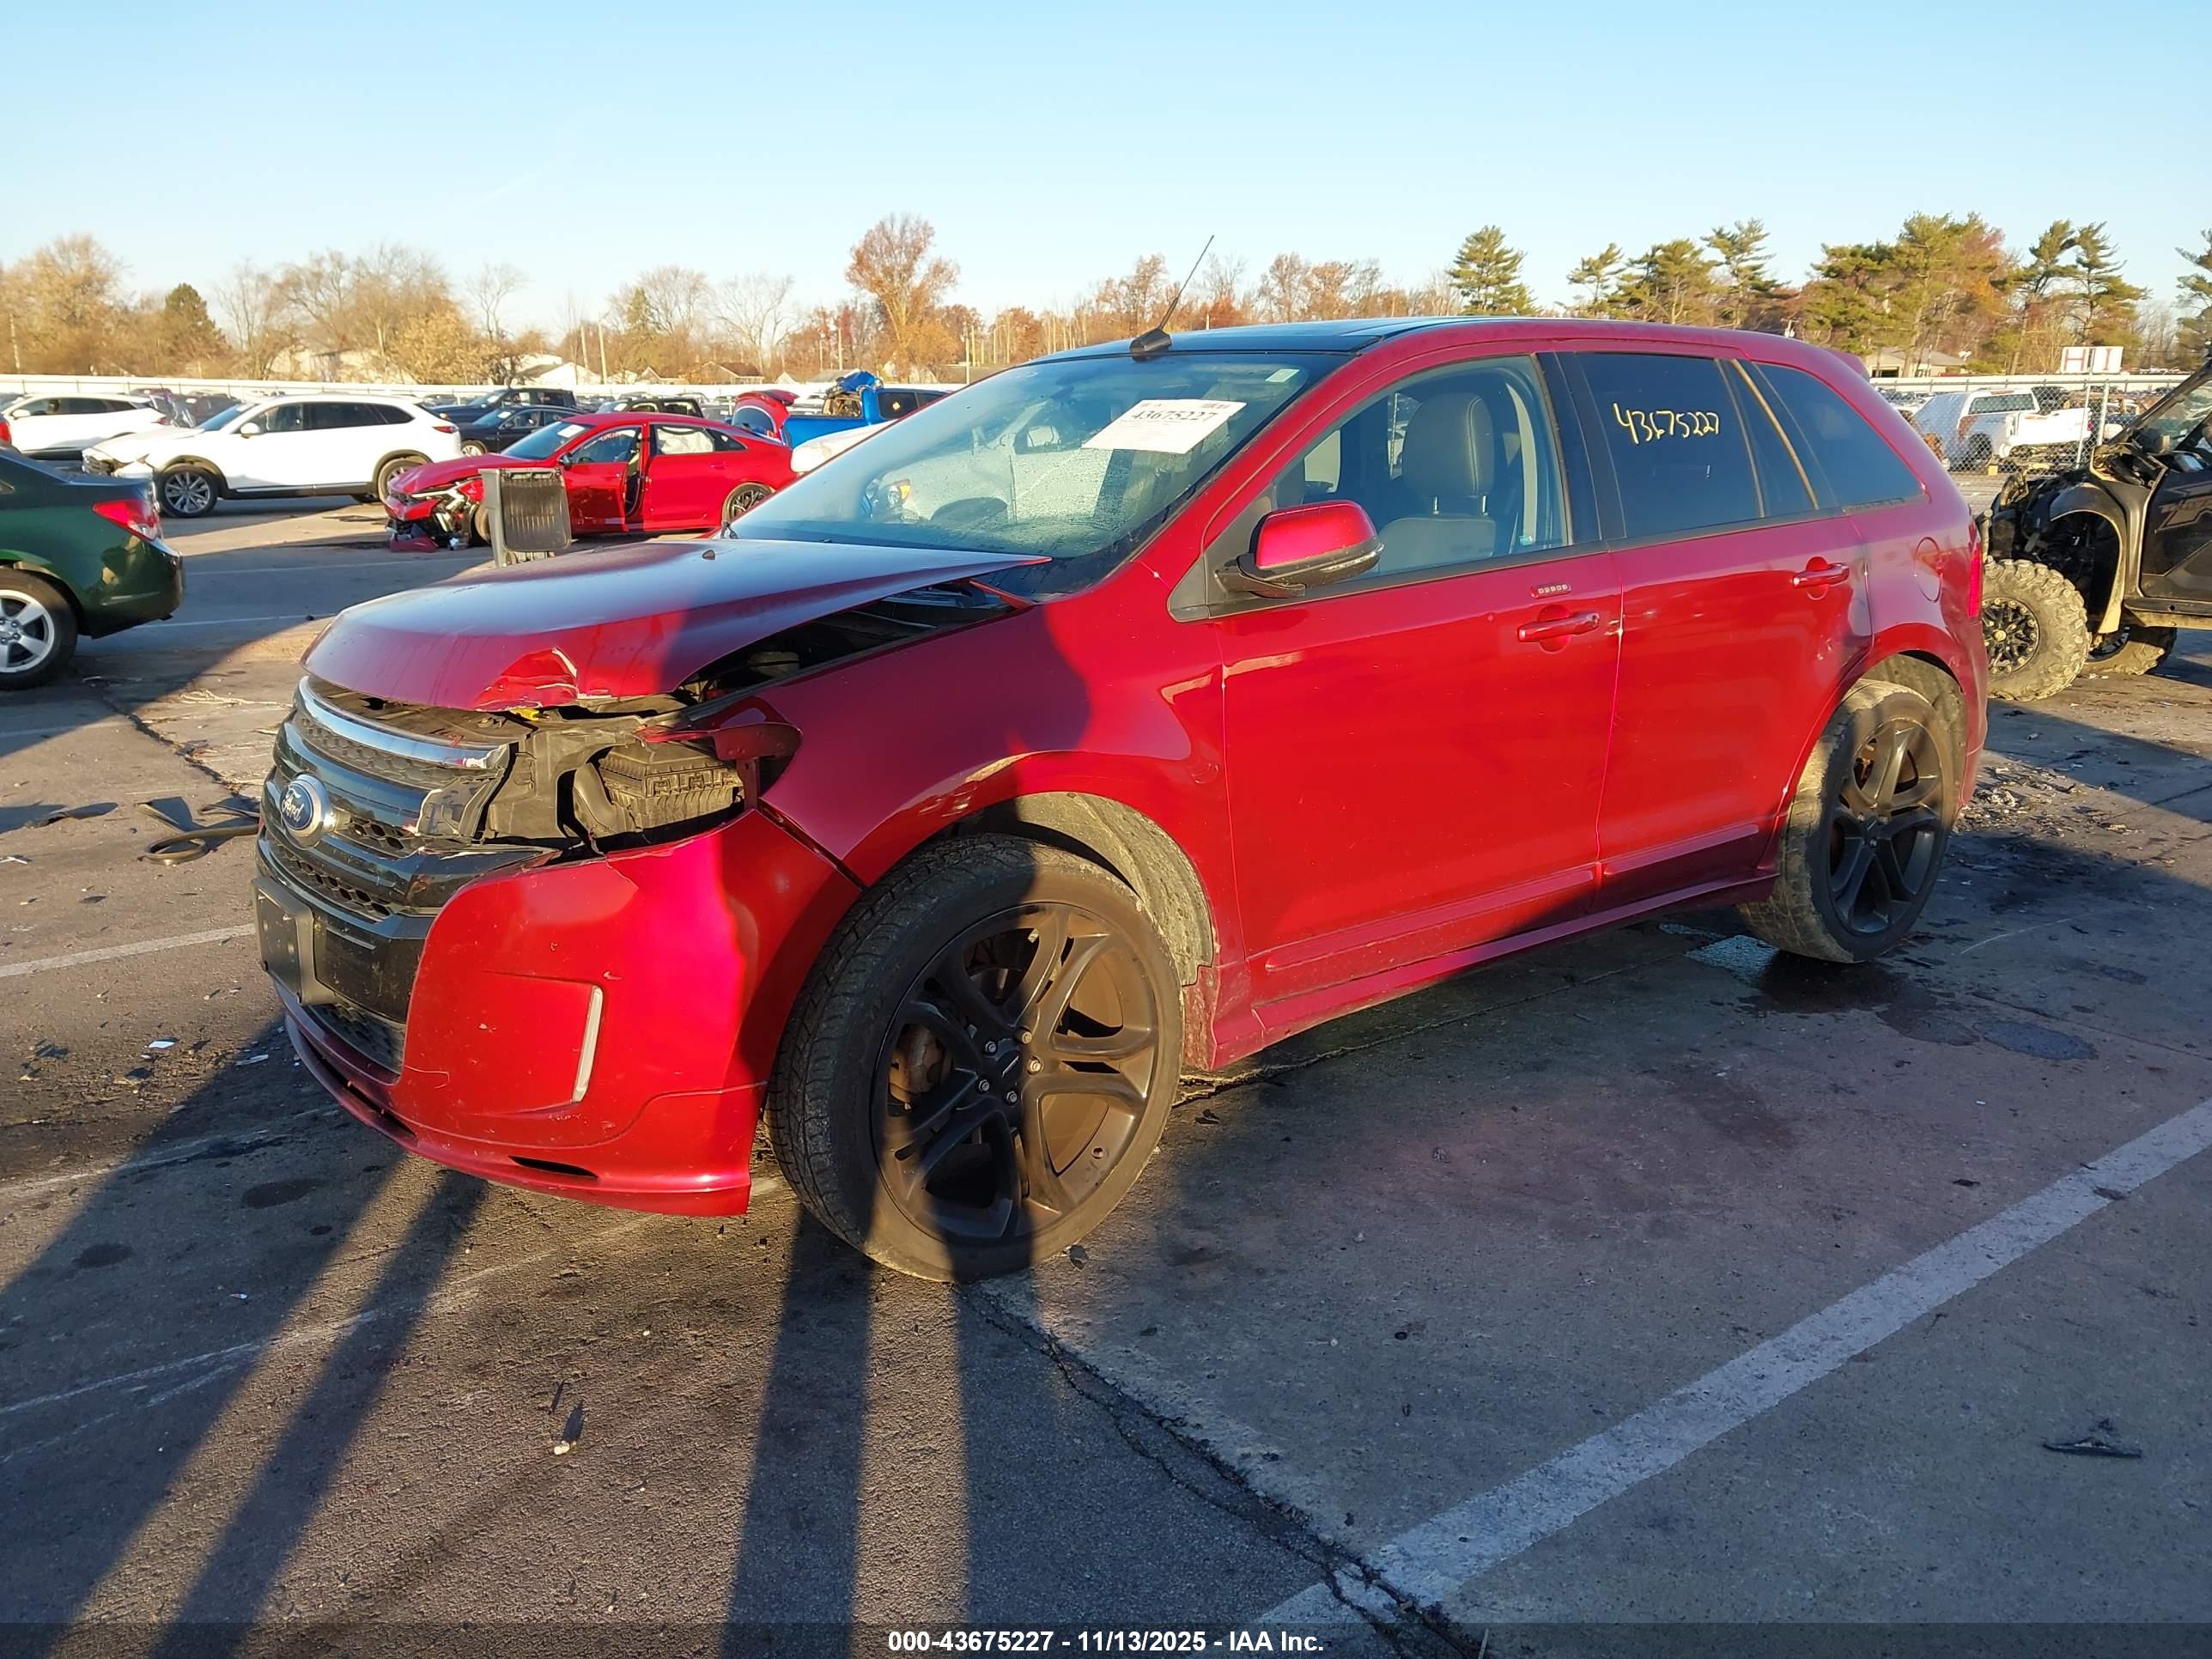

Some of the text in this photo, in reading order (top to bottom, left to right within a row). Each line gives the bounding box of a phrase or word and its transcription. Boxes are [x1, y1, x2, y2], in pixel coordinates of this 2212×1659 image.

[1132, 410, 1218, 422] 43675227
[1613, 402, 1720, 445] 43675227
[281, 787, 305, 823] Ford
